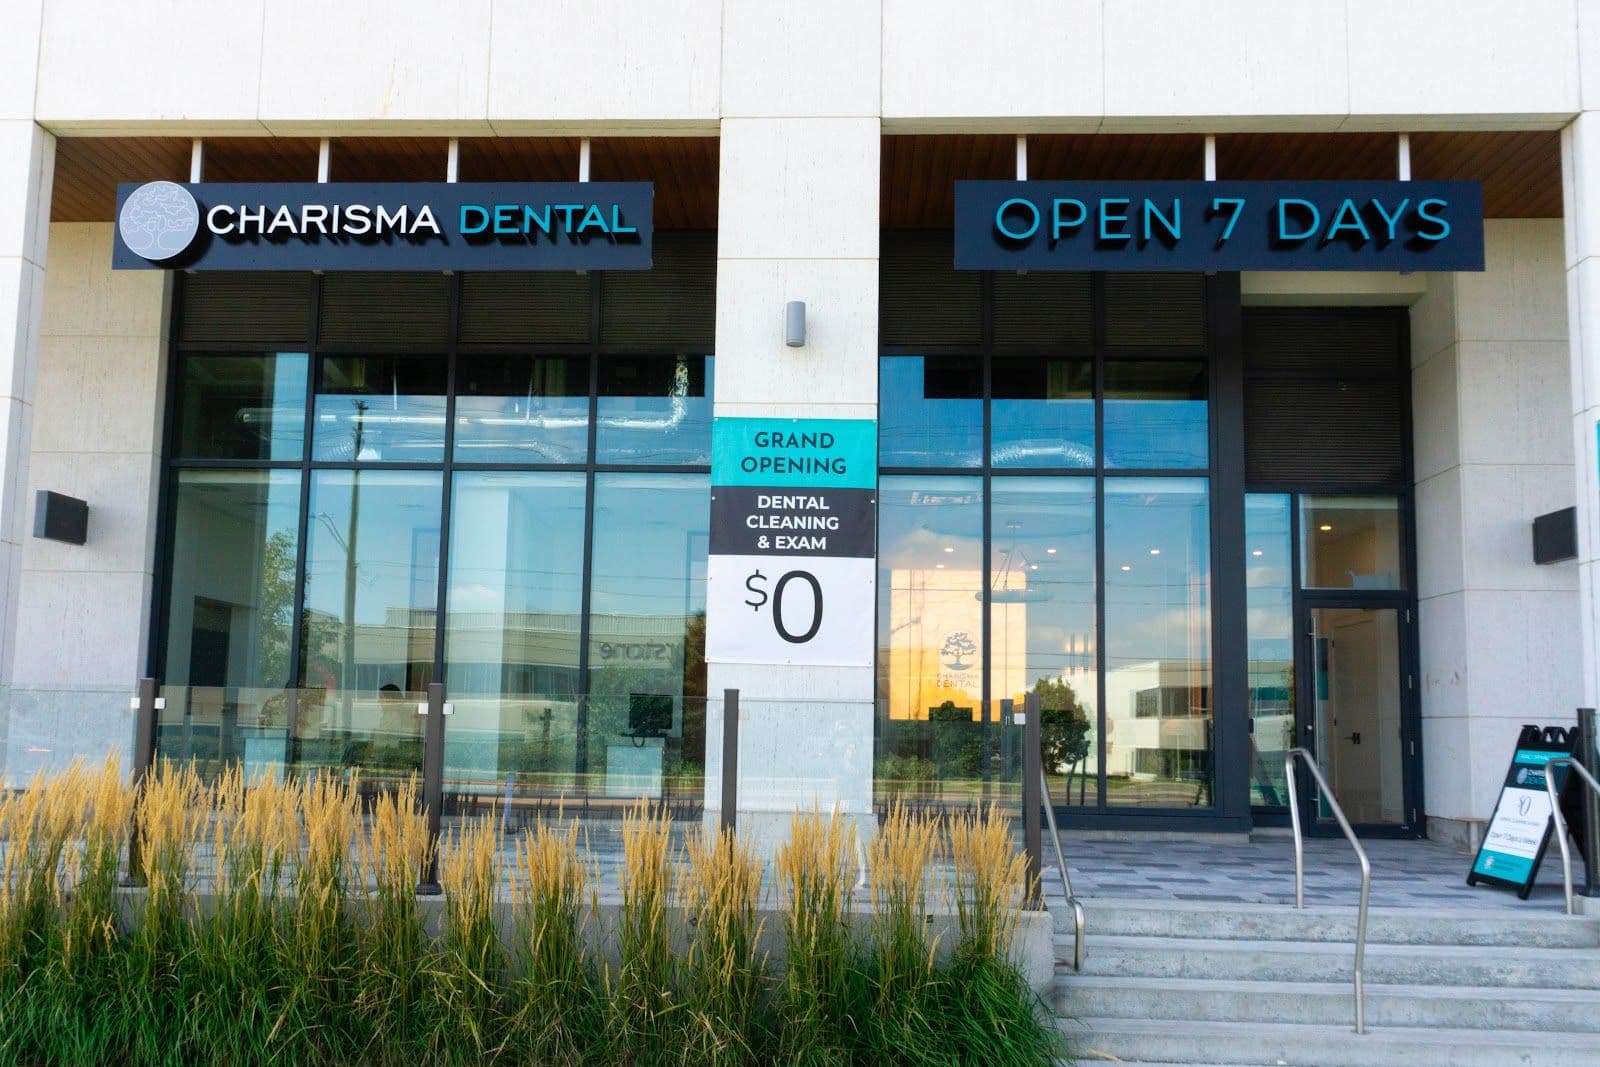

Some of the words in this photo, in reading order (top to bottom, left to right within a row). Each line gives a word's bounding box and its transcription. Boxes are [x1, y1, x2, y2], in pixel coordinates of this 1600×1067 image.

[206, 204, 441, 235] CHARISMA
[459, 204, 637, 234] DENTAL
[995, 197, 1182, 241] OPEN
[1212, 198, 1245, 240] 7
[1278, 198, 1451, 241] DAYS
[754, 431, 835, 449] GRAND
[741, 456, 847, 475] OPENING
[757, 495, 830, 510] DENTAL
[746, 515, 840, 530] CLEANING
[757, 535, 770, 549] &
[775, 535, 826, 550] EXAM
[744, 568, 824, 644] $0
[936, 679, 979, 688] DENTAL
